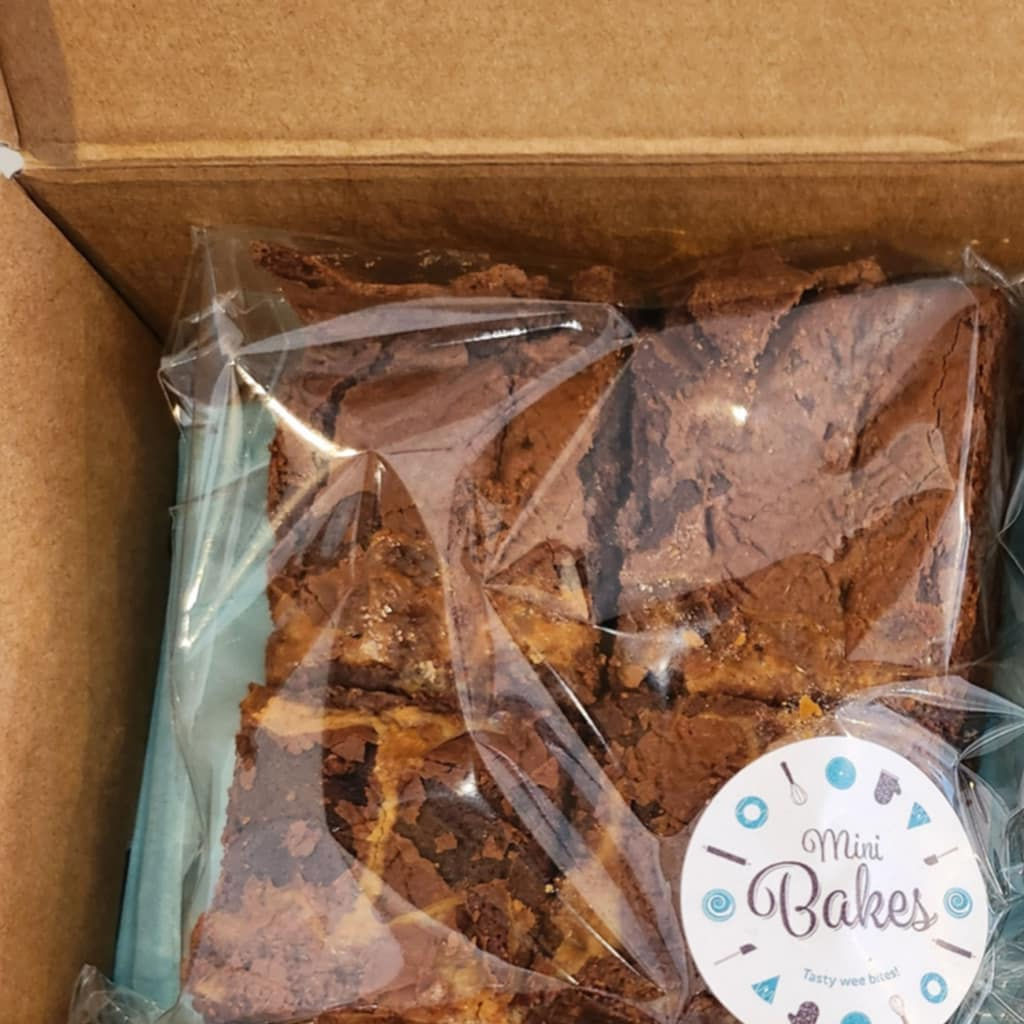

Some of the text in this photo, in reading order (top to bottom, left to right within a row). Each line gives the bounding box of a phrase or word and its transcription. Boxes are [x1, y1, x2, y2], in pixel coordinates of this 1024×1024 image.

[801, 828, 884, 862] Mini
[747, 860, 938, 940] Bakes
[803, 967, 837, 988] Tasty
[839, 975, 866, 987] wee
